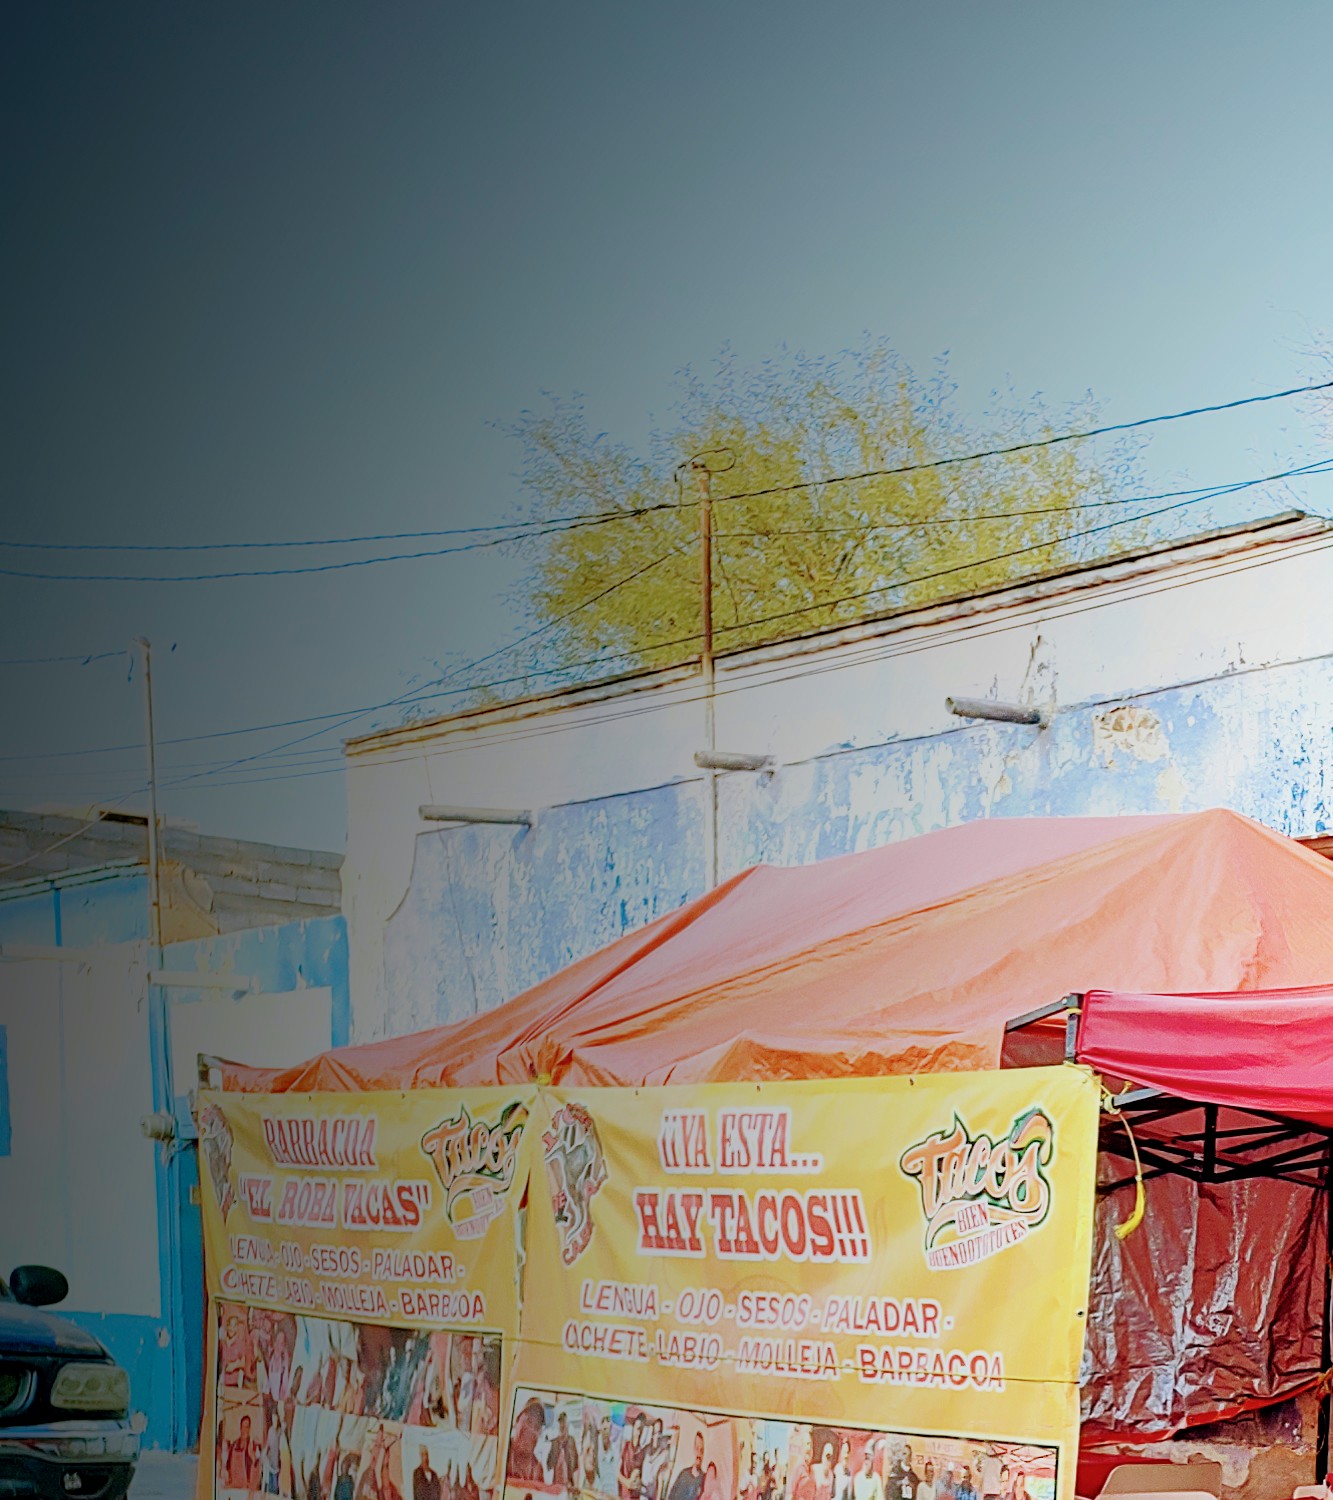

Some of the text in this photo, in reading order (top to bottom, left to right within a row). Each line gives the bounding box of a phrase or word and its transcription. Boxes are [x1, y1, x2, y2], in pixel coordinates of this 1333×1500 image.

[263, 1118, 377, 1167] BARBACOA
[720, 1112, 819, 1168] ESTA...
[279, 1182, 337, 1221] ROBA
[637, 1193, 868, 1257] HAY TACOS!!!
[957, 1203, 989, 1233] BIEN
[281, 1243, 302, 1270] OJO
[311, 1249, 361, 1276] SESOS
[374, 1252, 454, 1280] PALADAR
[321, 1283, 388, 1313] MOLLEJA
[582, 1283, 938, 1334] LENGUA OJO SESOS PALADAR
[657, 1332, 721, 1365] LABIO
[739, 1340, 838, 1376] MOLLEJA
[860, 1348, 1003, 1389] BARBACOA
